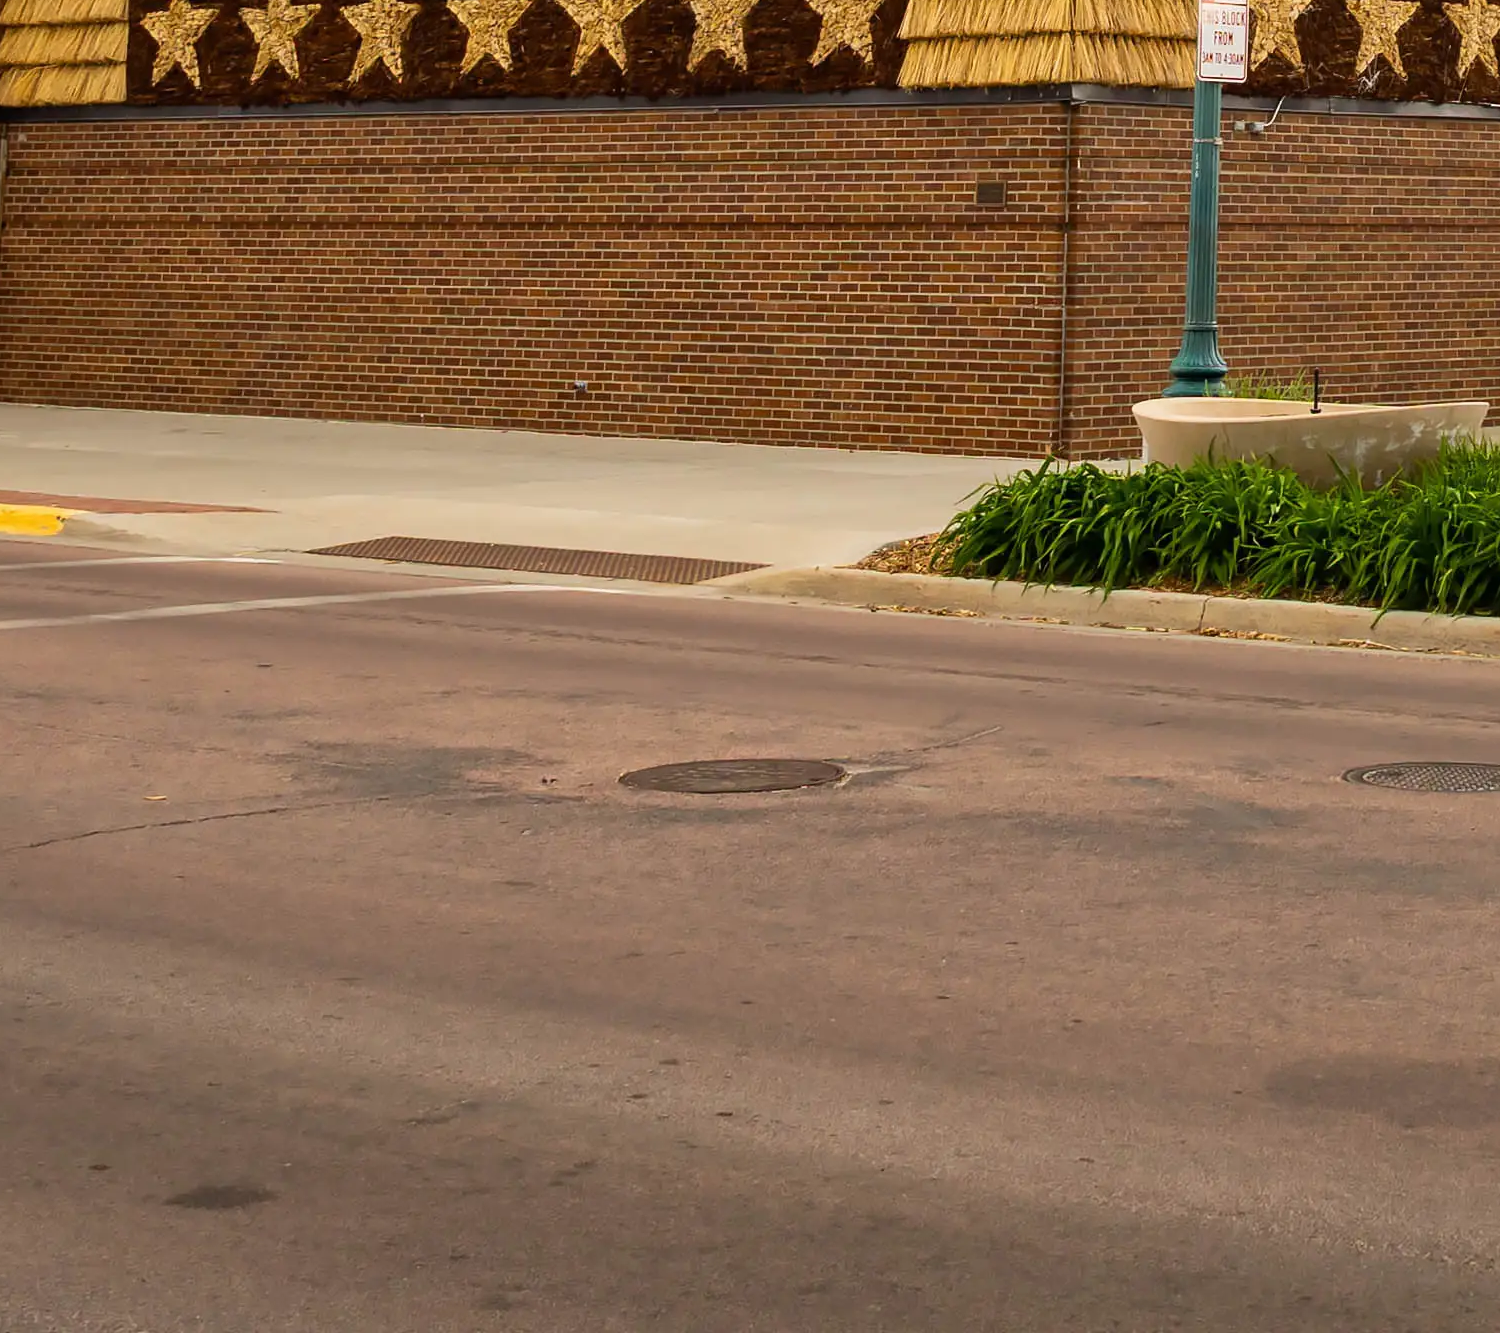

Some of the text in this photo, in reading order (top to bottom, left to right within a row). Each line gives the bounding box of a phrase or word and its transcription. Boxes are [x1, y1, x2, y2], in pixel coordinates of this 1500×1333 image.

[1203, 10, 1245, 25] THIS BLOCK
[1214, 30, 1234, 45] FROM
